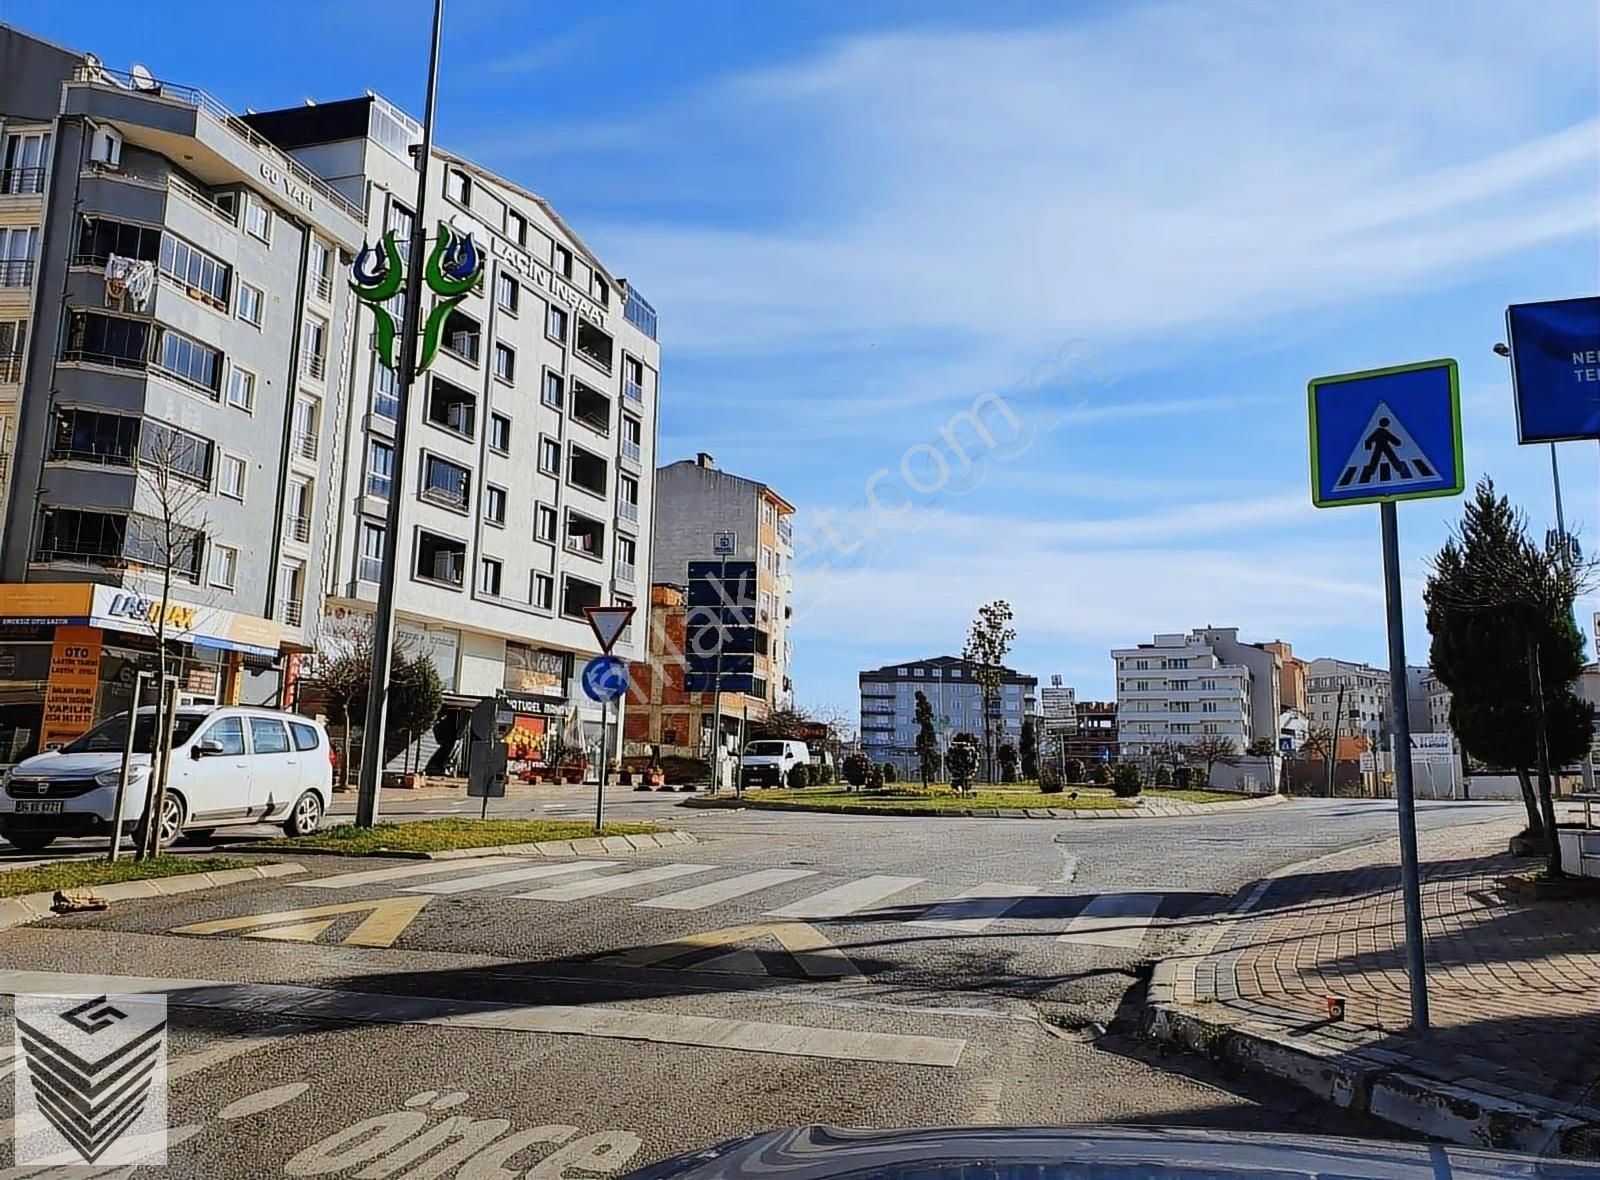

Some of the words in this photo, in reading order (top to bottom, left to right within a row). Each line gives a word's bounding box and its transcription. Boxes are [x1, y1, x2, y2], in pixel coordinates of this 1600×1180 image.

[283, 177, 314, 212] YAPI
[1572, 351, 1600, 365] NE
[1574, 368, 1600, 382] TE
[65, 647, 89, 658] OTO
[47, 704, 93, 713] YAPILIR
